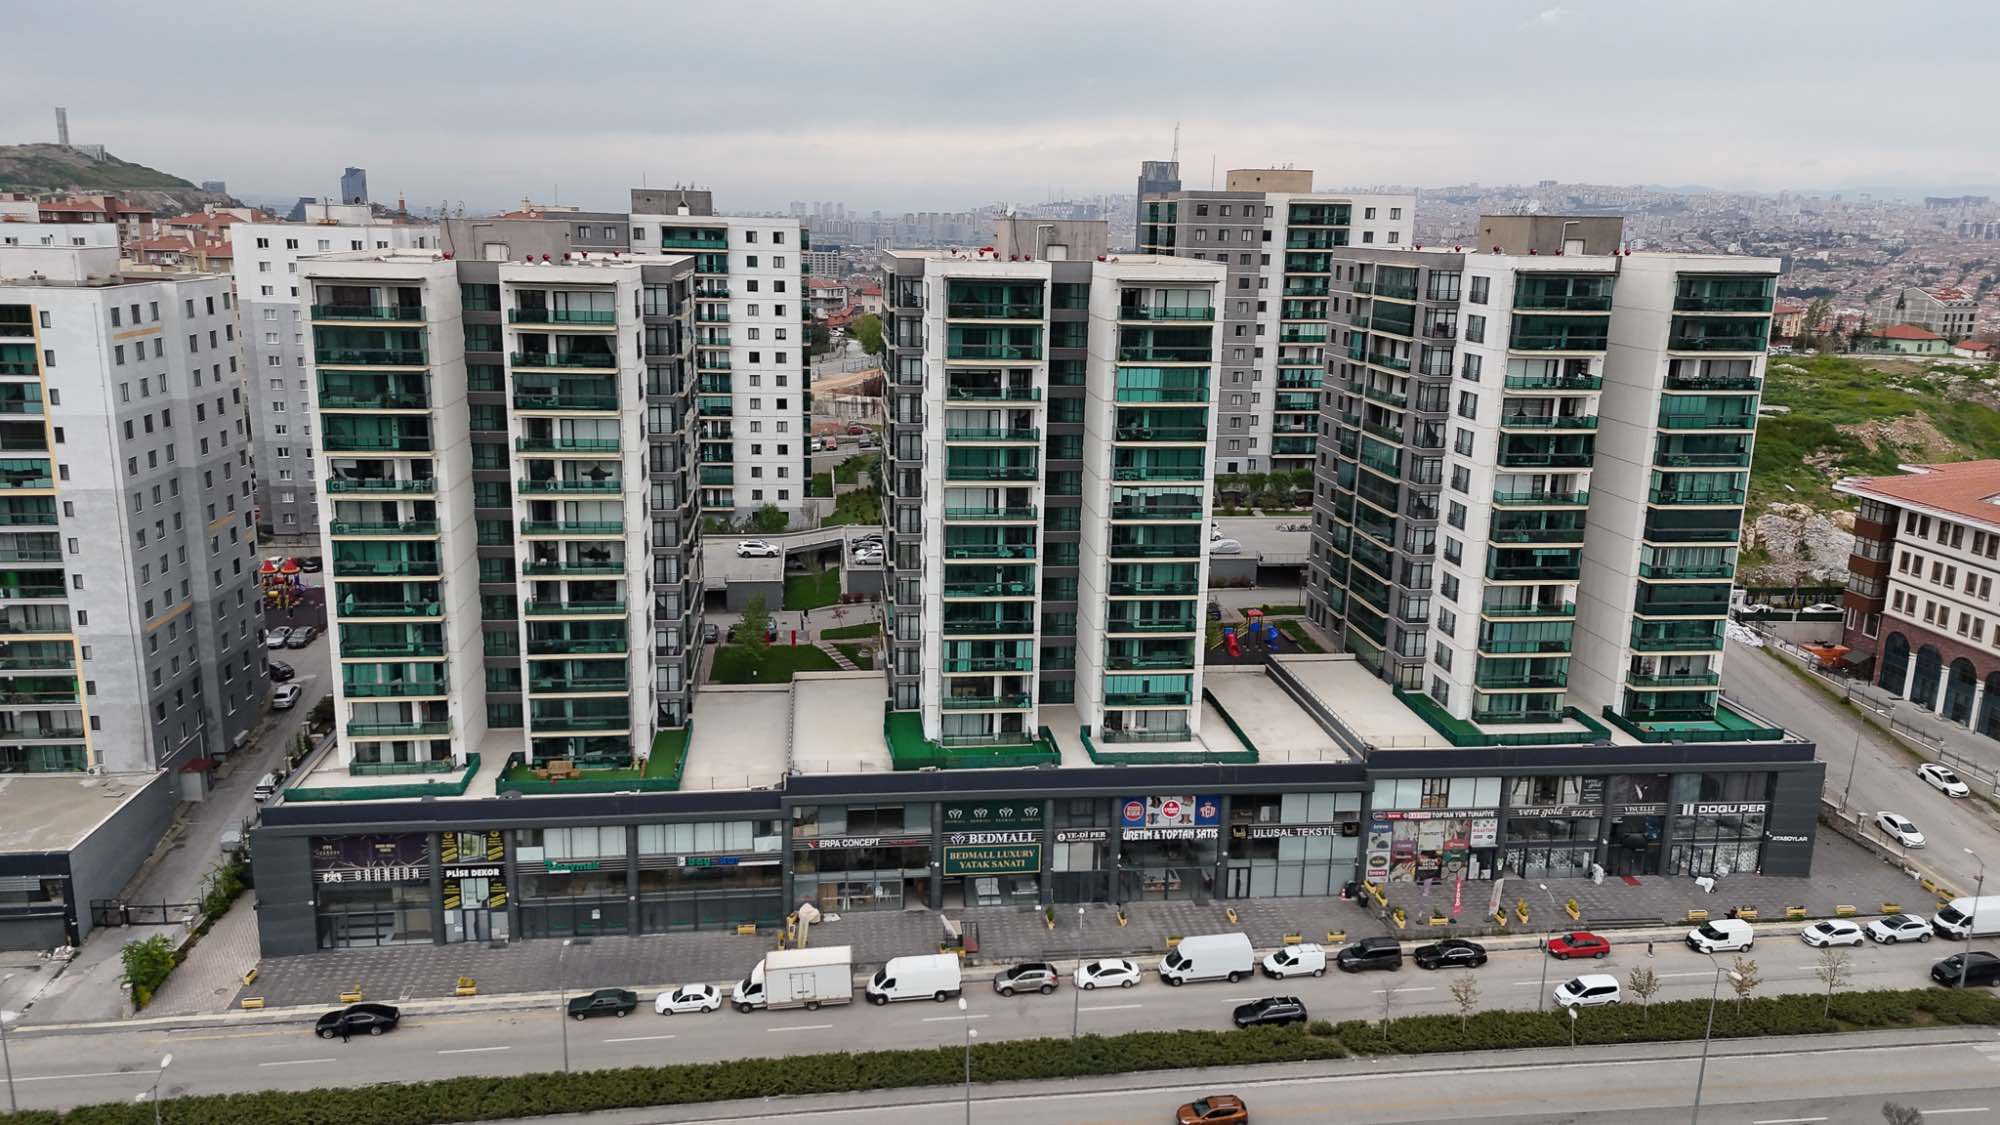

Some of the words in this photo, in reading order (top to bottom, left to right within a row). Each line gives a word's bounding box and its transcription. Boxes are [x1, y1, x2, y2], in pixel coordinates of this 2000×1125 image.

[1739, 804, 1766, 813] PER
[1432, 811, 1454, 819] TOPTAN
[1122, 828, 1153, 841] ÜRETİM
[1154, 830, 1161, 840] &
[1162, 829, 1194, 841] TOPTAN
[1253, 828, 1294, 838] ULUSAL
[1296, 826, 1337, 837] TEKSTİL
[819, 839, 841, 849] ERPA
[842, 838, 881, 848] CONCEPT
[968, 832, 1037, 845] BEDMALL
[950, 850, 996, 861] BEDMALL
[997, 849, 1034, 860] LUXURY
[959, 861, 990, 870] YATAK
[991, 859, 1026, 869] SANATI
[354, 866, 419, 882] GRANADA
[446, 868, 469, 878] PLİSE
[471, 867, 500, 877] DEKOR
